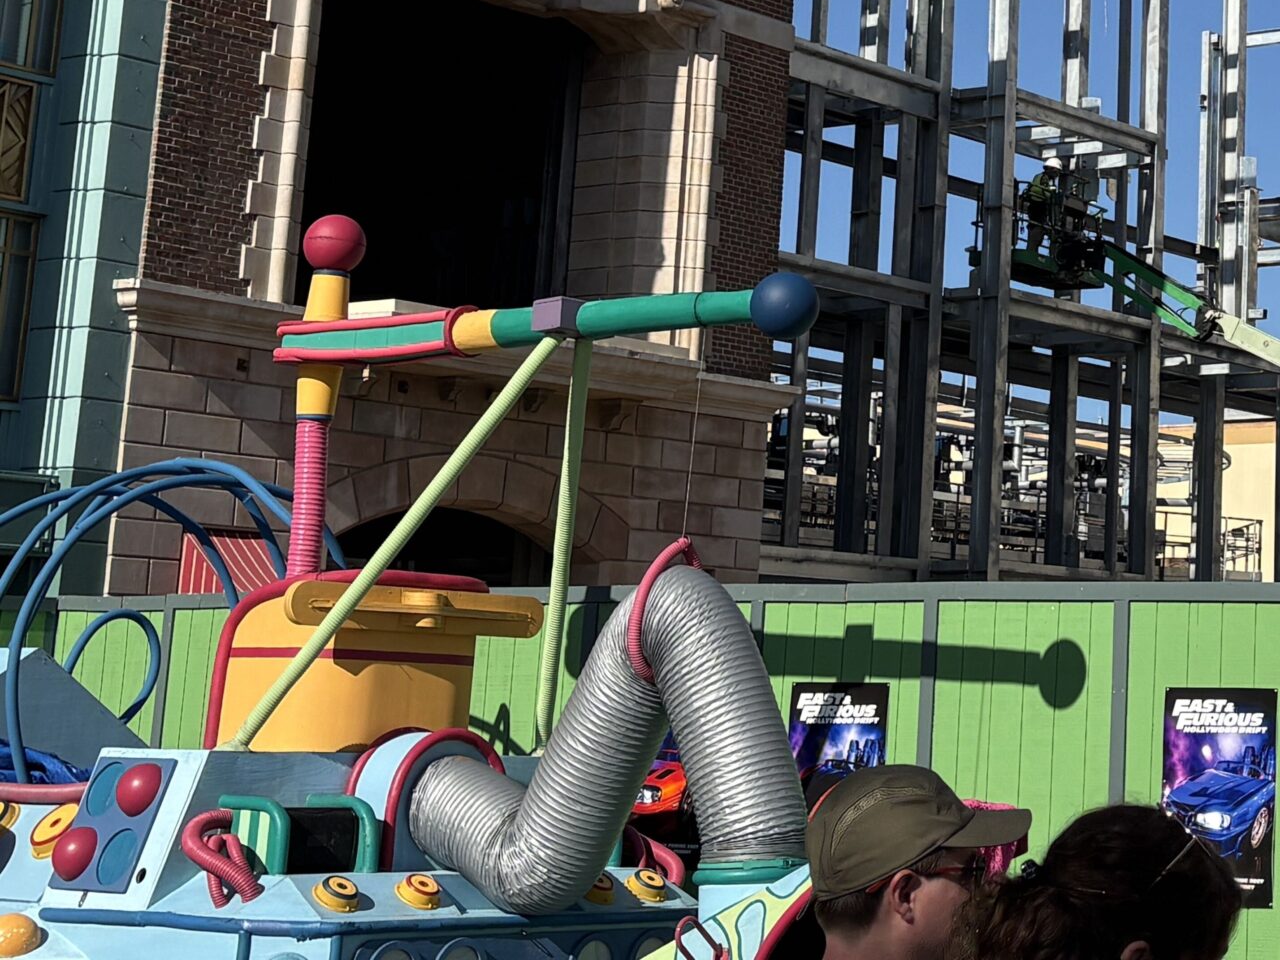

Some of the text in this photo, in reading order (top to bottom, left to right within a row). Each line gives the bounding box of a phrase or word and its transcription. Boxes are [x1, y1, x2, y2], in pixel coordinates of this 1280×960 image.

[800, 704, 877, 721] FURIOUS
[1172, 699, 1227, 716] FAST
[1176, 712, 1264, 730] FURIOUS
[1183, 726, 1268, 734] HOLLYWOOD DRIFT
